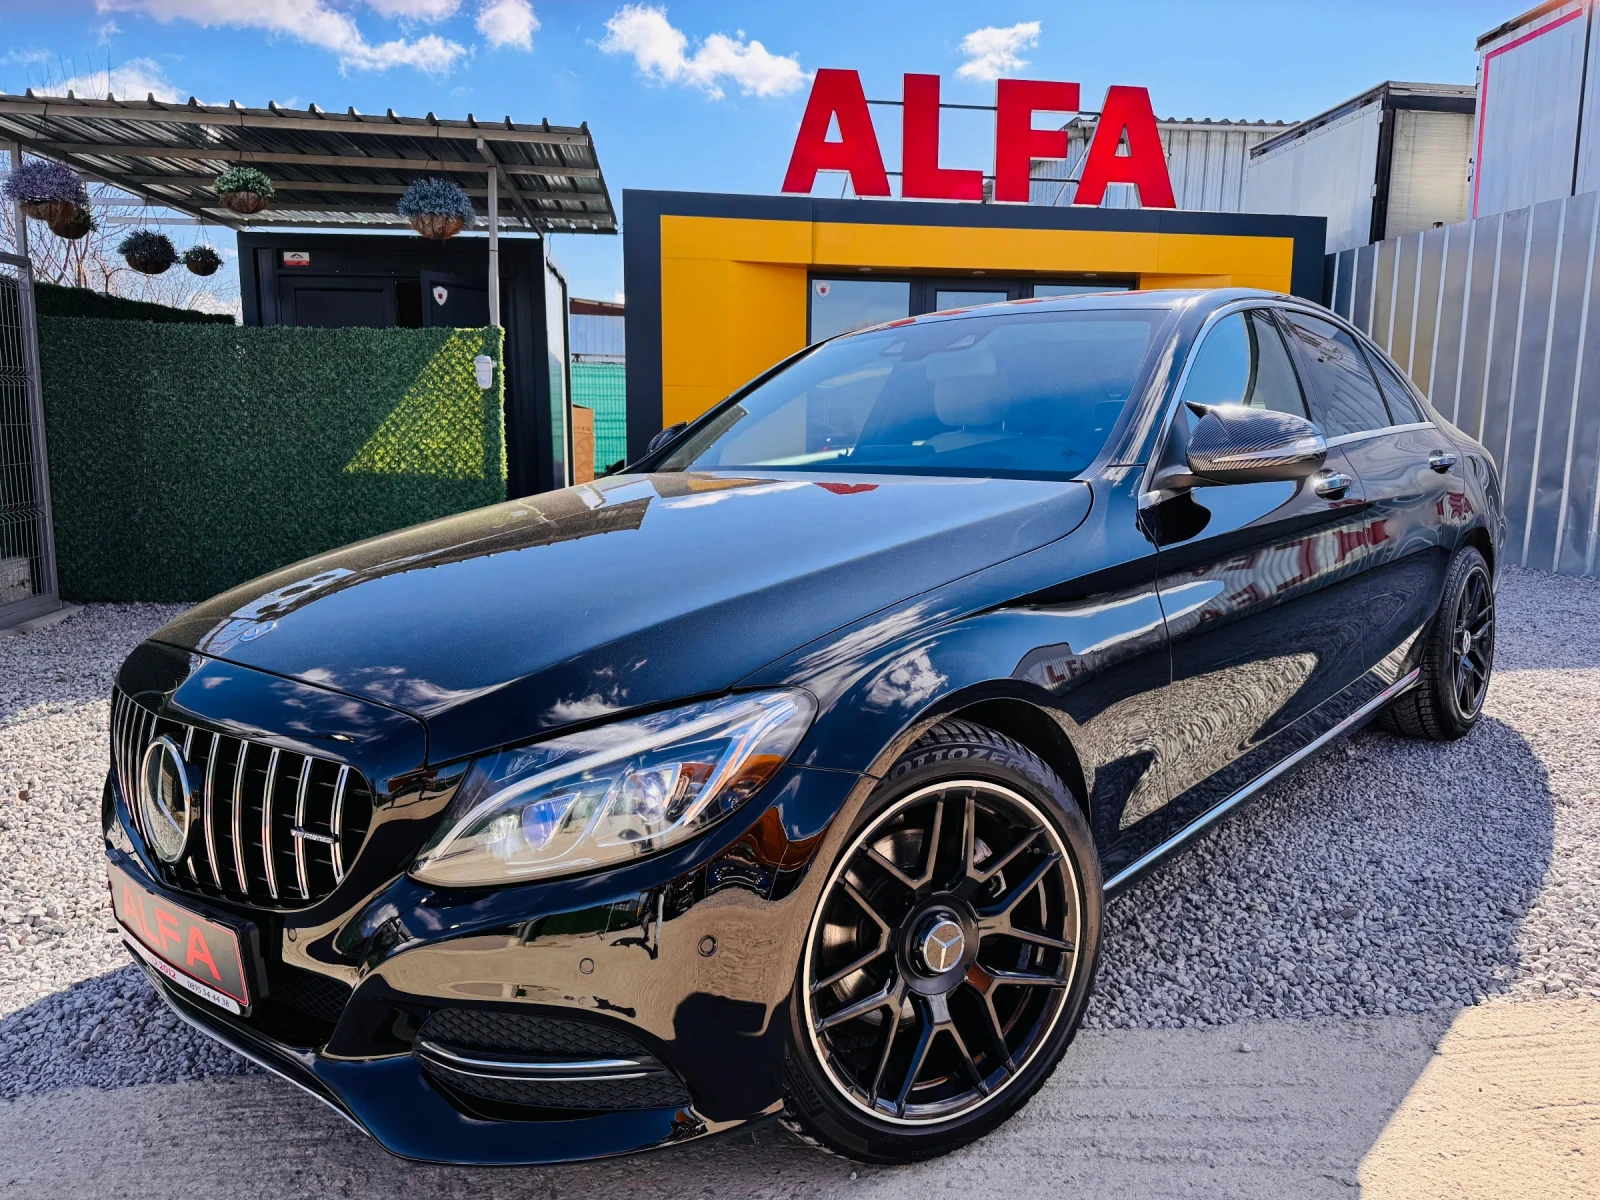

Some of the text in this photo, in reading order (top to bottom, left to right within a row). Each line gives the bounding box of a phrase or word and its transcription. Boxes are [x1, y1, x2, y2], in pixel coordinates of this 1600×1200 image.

[781, 68, 1176, 209] ALFA
[123, 884, 222, 981] ALFA
[159, 962, 177, 980] 2012
[212, 994, 221, 1004] 44
